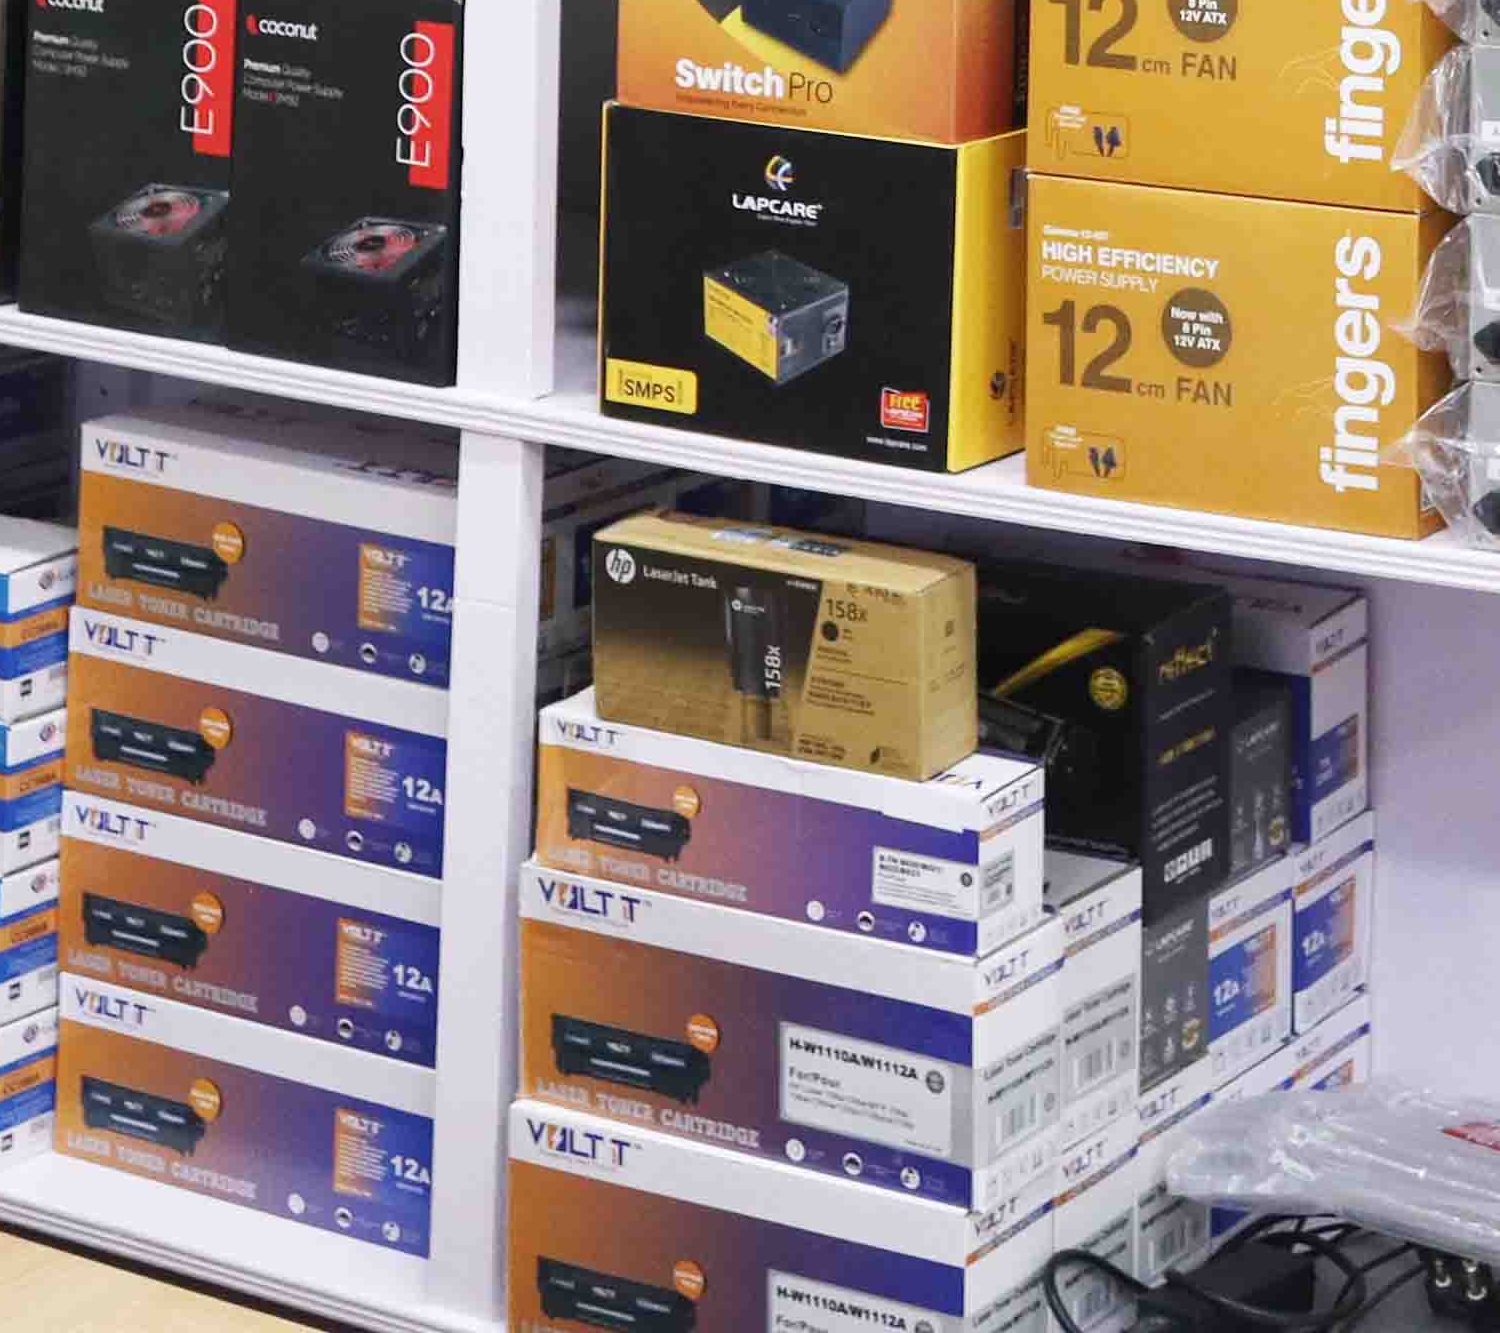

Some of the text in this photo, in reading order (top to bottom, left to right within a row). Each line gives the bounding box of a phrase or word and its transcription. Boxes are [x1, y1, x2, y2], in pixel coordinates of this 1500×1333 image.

[259, 17, 317, 41] coconut
[1179, 10, 1227, 26] 12V ATX
[180, 4, 218, 136] E900
[676, 58, 833, 104] Switch Pro
[1141, 58, 1171, 76] cm
[1181, 52, 1237, 82] FAN
[396, 32, 436, 167] E900
[732, 193, 819, 220] LAPCARE
[1041, 241, 1219, 279] HIGH EFFICIENCY
[1041, 265, 1158, 293] POWER SUPPLY
[1042, 299, 1234, 408] 12 cm FAN
[1174, 335, 1221, 352] 12V ATX
[1319, 228, 1397, 493] fingers
[623, 379, 676, 403] SMPS
[643, 565, 690, 587] LaserJet
[691, 571, 717, 590] Tank
[403, 776, 442, 805] 12A
[393, 964, 433, 995] 12A
[390, 1155, 431, 1187] 12A
